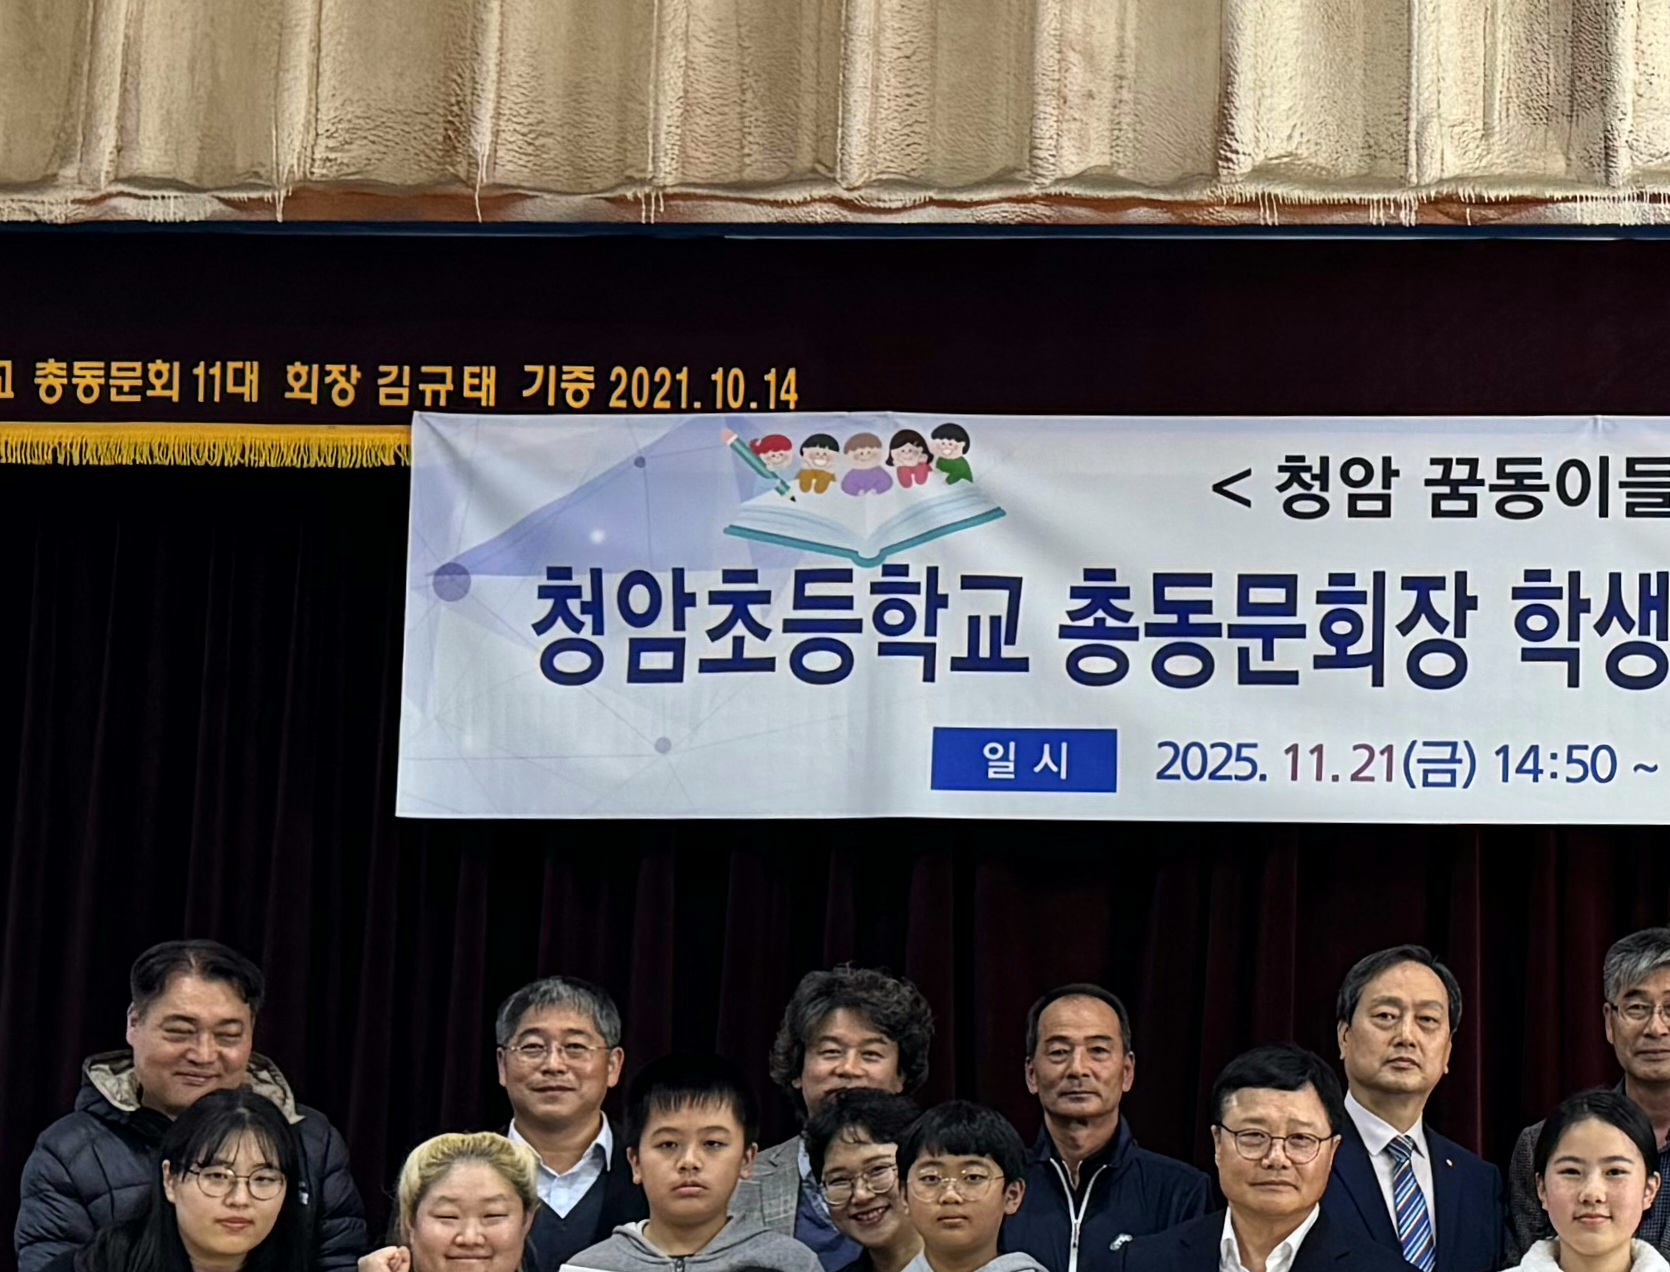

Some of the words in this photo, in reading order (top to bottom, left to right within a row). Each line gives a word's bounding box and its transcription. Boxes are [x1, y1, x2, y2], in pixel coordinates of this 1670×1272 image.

[34, 358, 180, 405] 총동문회
[284, 361, 362, 407] 회장
[377, 365, 496, 407] 김규태
[522, 364, 595, 408] 기증
[1275, 454, 1401, 520] 청암
[531, 564, 1030, 687] 청암초등학교
[1058, 567, 1479, 691] 총동문회장
[1494, 744, 1618, 784] 14:50
